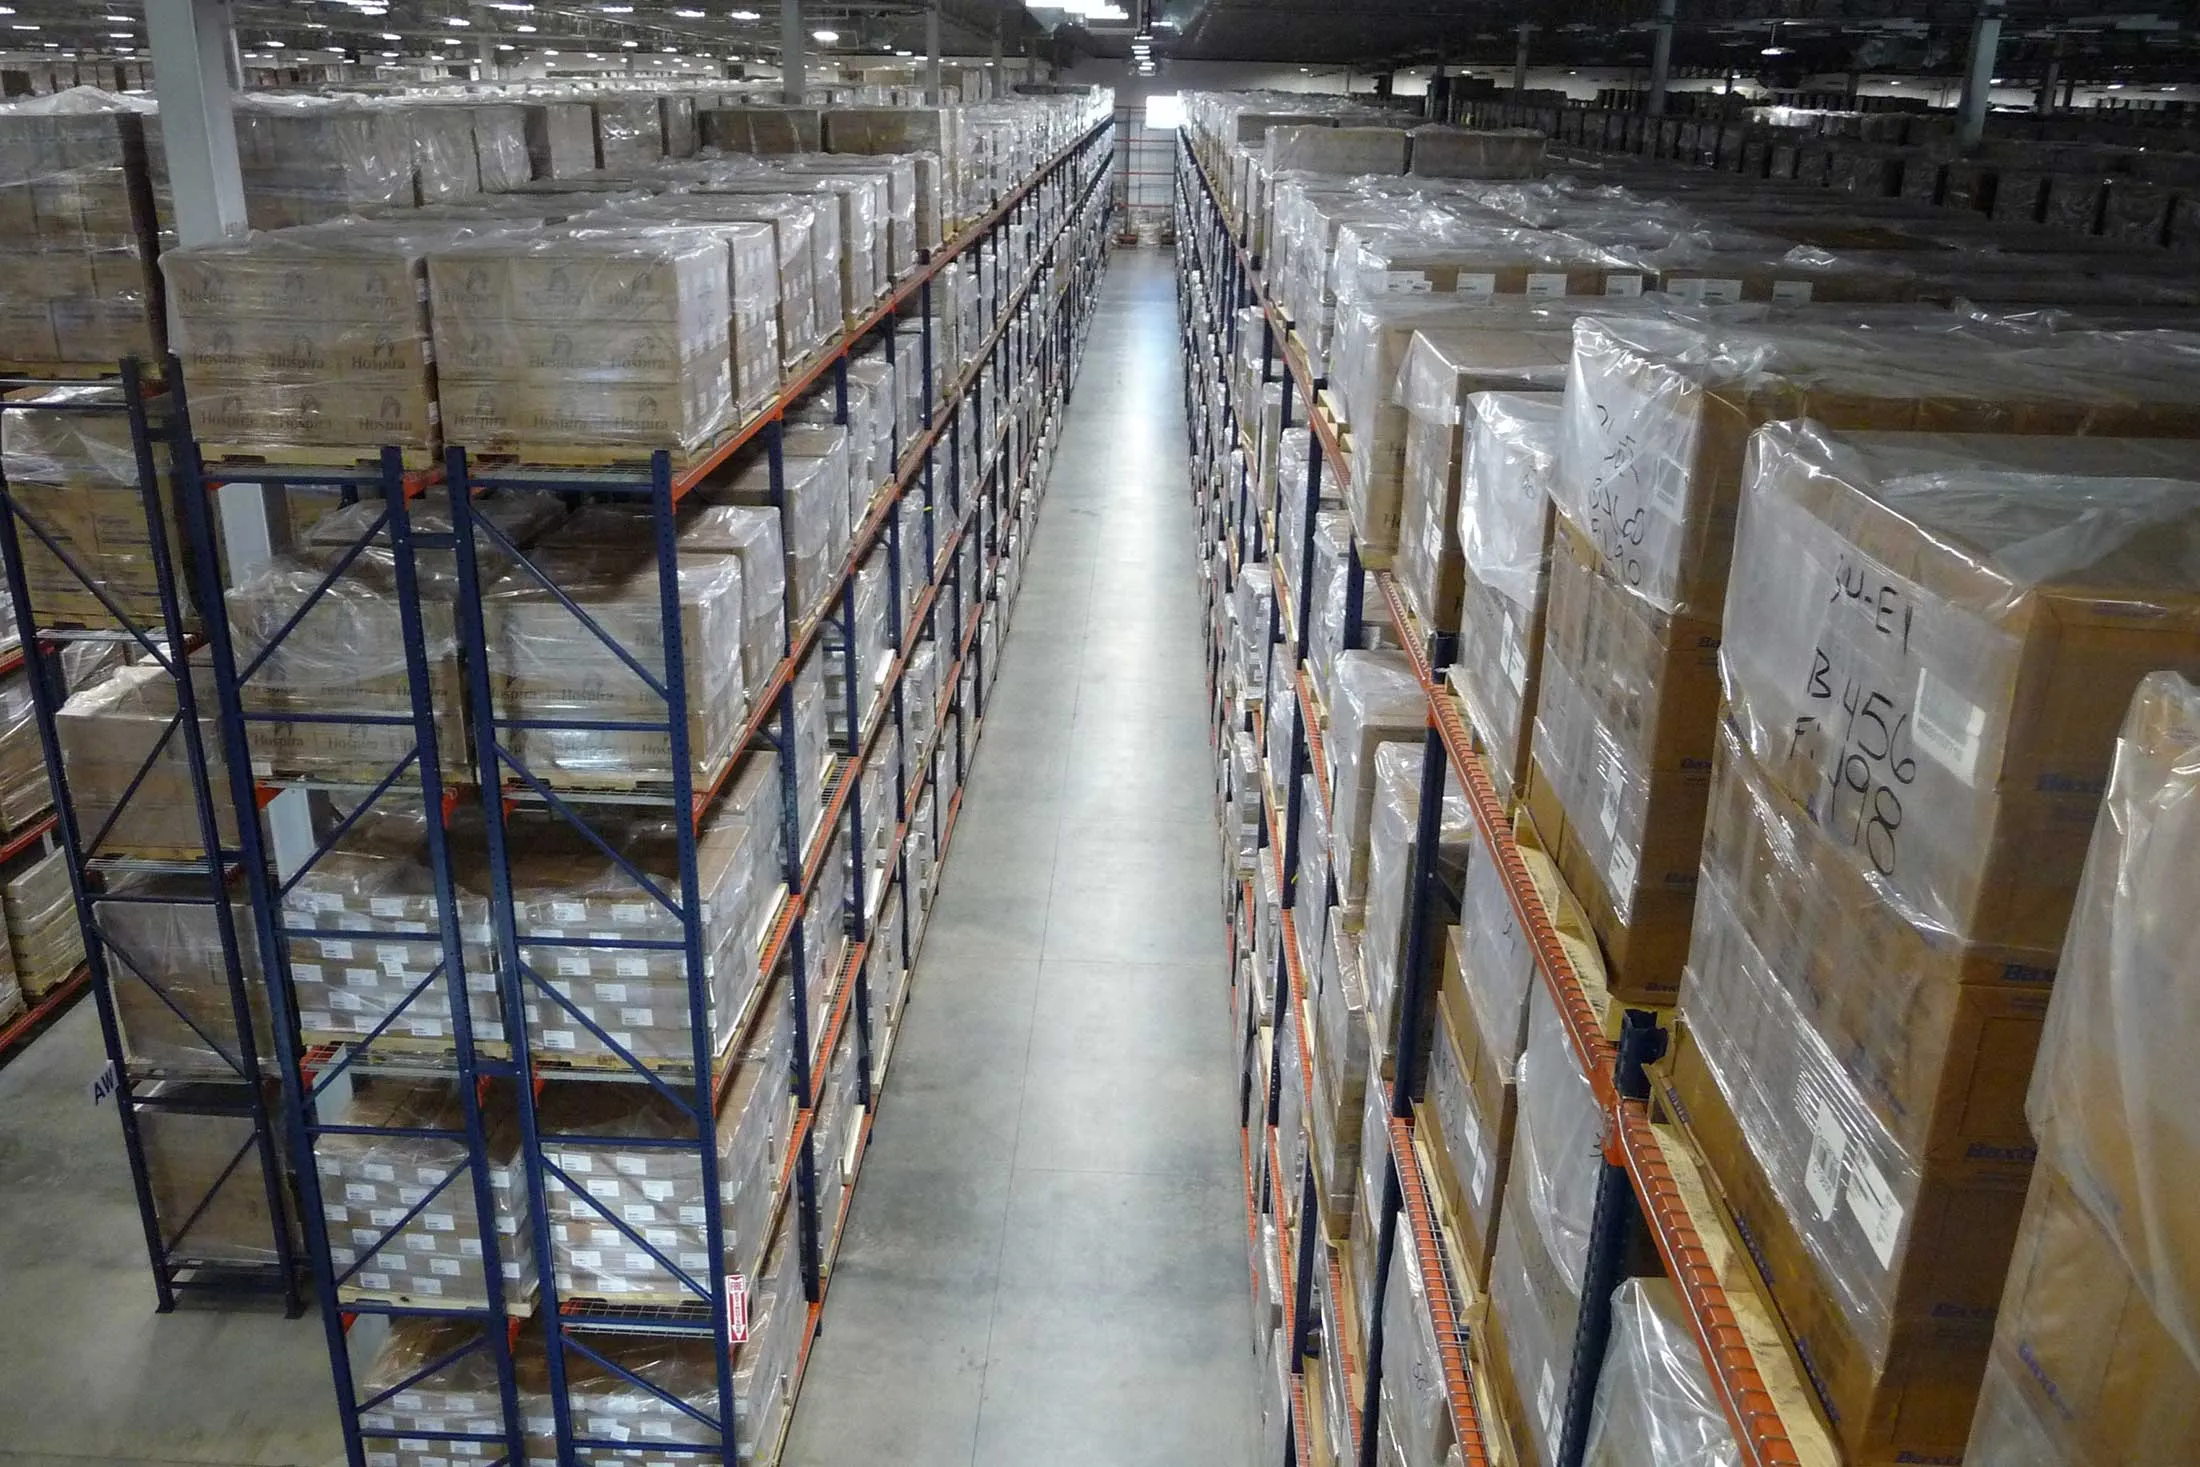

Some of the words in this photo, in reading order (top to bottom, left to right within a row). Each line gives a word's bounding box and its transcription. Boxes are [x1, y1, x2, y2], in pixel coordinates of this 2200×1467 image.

[351, 356, 406, 371] Hospira
[358, 417, 413, 432] Hospira
[254, 734, 304, 751] Hospira
[94, 1067, 114, 1107] AW
